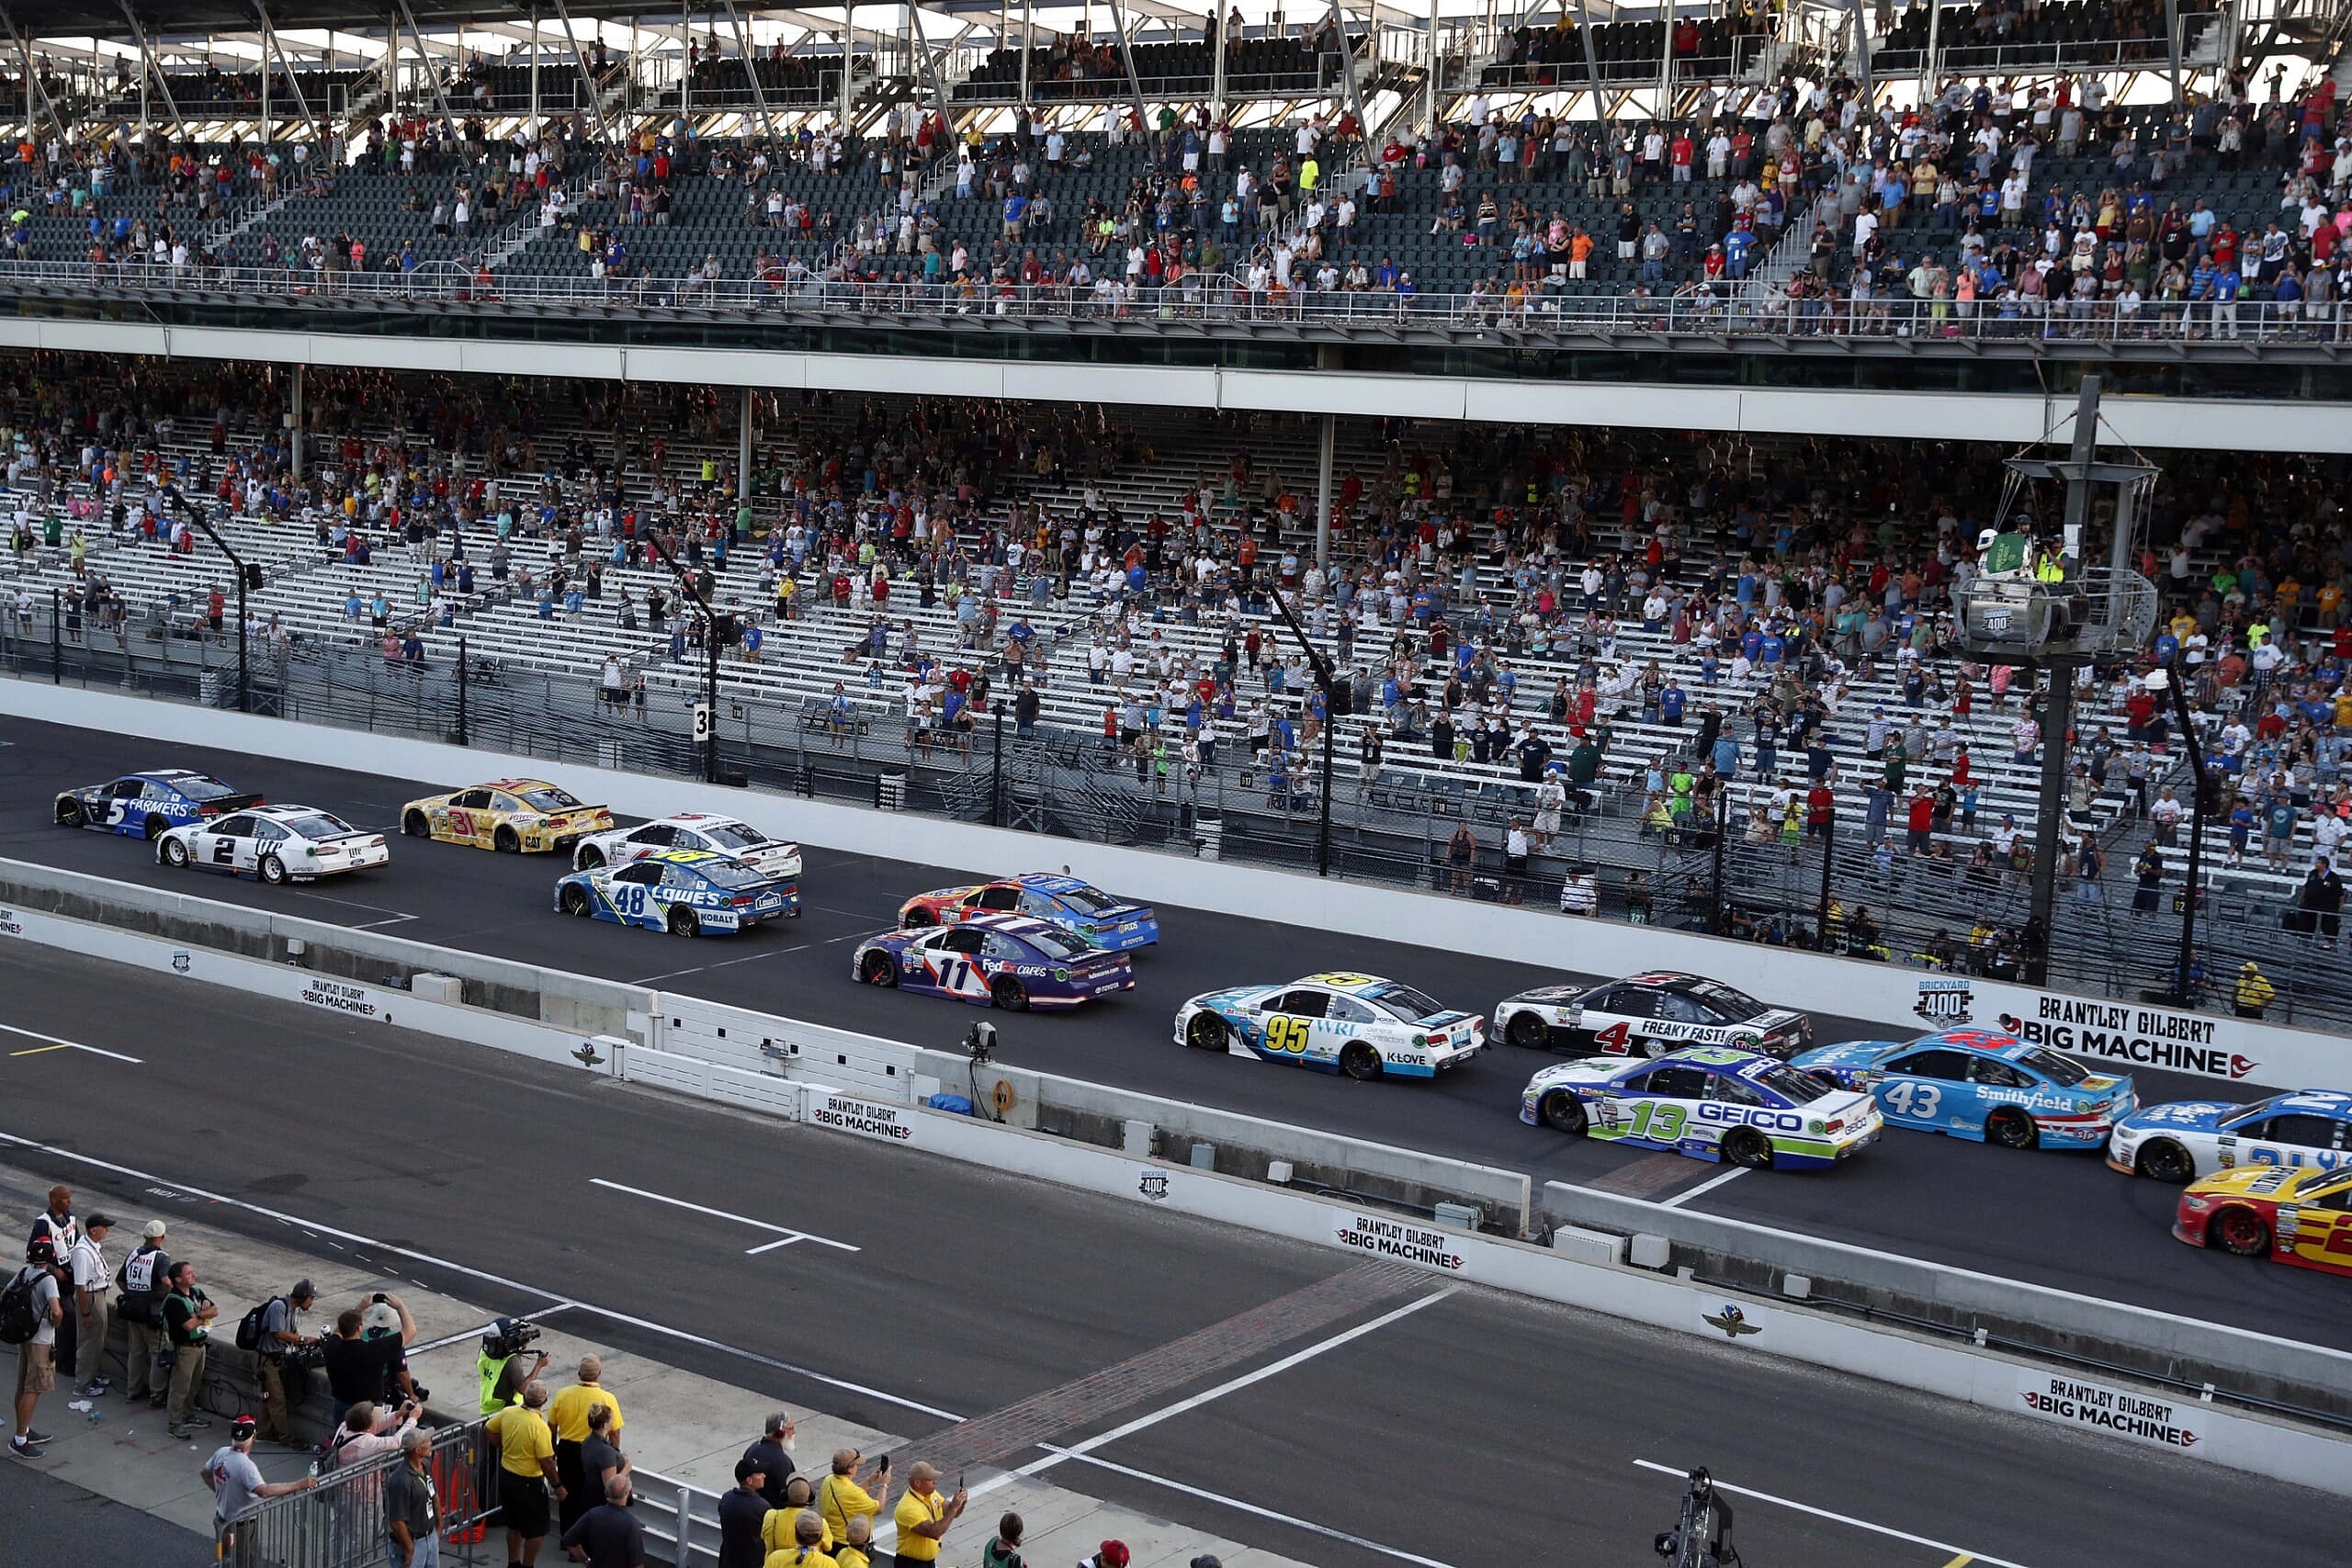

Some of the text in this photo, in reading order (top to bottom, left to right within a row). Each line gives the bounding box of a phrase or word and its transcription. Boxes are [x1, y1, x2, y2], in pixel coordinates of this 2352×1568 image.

[1987, 617, 2007, 630] 400
[695, 710, 707, 734] 3
[107, 799, 127, 825] 5
[129, 798, 187, 818] FARMERS
[448, 809, 476, 837] 31
[213, 837, 235, 864] 2
[525, 836, 541, 848] CAT
[614, 885, 647, 918] 48
[650, 887, 721, 907] LOWE'S
[700, 912, 734, 924] KOBALT
[938, 958, 970, 990] 11
[1918, 980, 1970, 990] BRICKYARD
[312, 979, 340, 997] BRANTLEY
[308, 991, 368, 1015] BIG MACHINE
[1926, 993, 1961, 1015] 400
[1316, 1020, 1362, 1038] WRL
[1642, 1021, 1690, 1039] FREAKY
[1691, 1027, 1726, 1043] FAST!
[2039, 997, 2215, 1044] BRANTLEY GILBERT
[1265, 1015, 1312, 1054] 95
[1594, 1021, 1633, 1056] 4
[1387, 1052, 1426, 1065] K-LOVE
[2023, 1021, 2228, 1075] BIG MACHINE
[1736, 1055, 1781, 1078] GEICO
[828, 1098, 897, 1122] BRANTLEY GILBERT
[1884, 1081, 1941, 1119] 43
[1976, 1086, 2074, 1112] Smithfield
[823, 1111, 902, 1139] BIG MACHINE
[1630, 1100, 1687, 1141] 13
[1698, 1103, 1803, 1132] GEICO
[1845, 1117, 1867, 1135] GEICO
[2075, 1130, 2096, 1141] STP
[1145, 1179, 1162, 1192] 400
[1357, 1217, 1445, 1249] BRANTLEY GILBERT
[1349, 1232, 1451, 1268] BIG MACHINE
[2050, 1379, 2173, 1423] BRANTLEY GILBERT
[2039, 1394, 2180, 1445] BIG MACHINE
